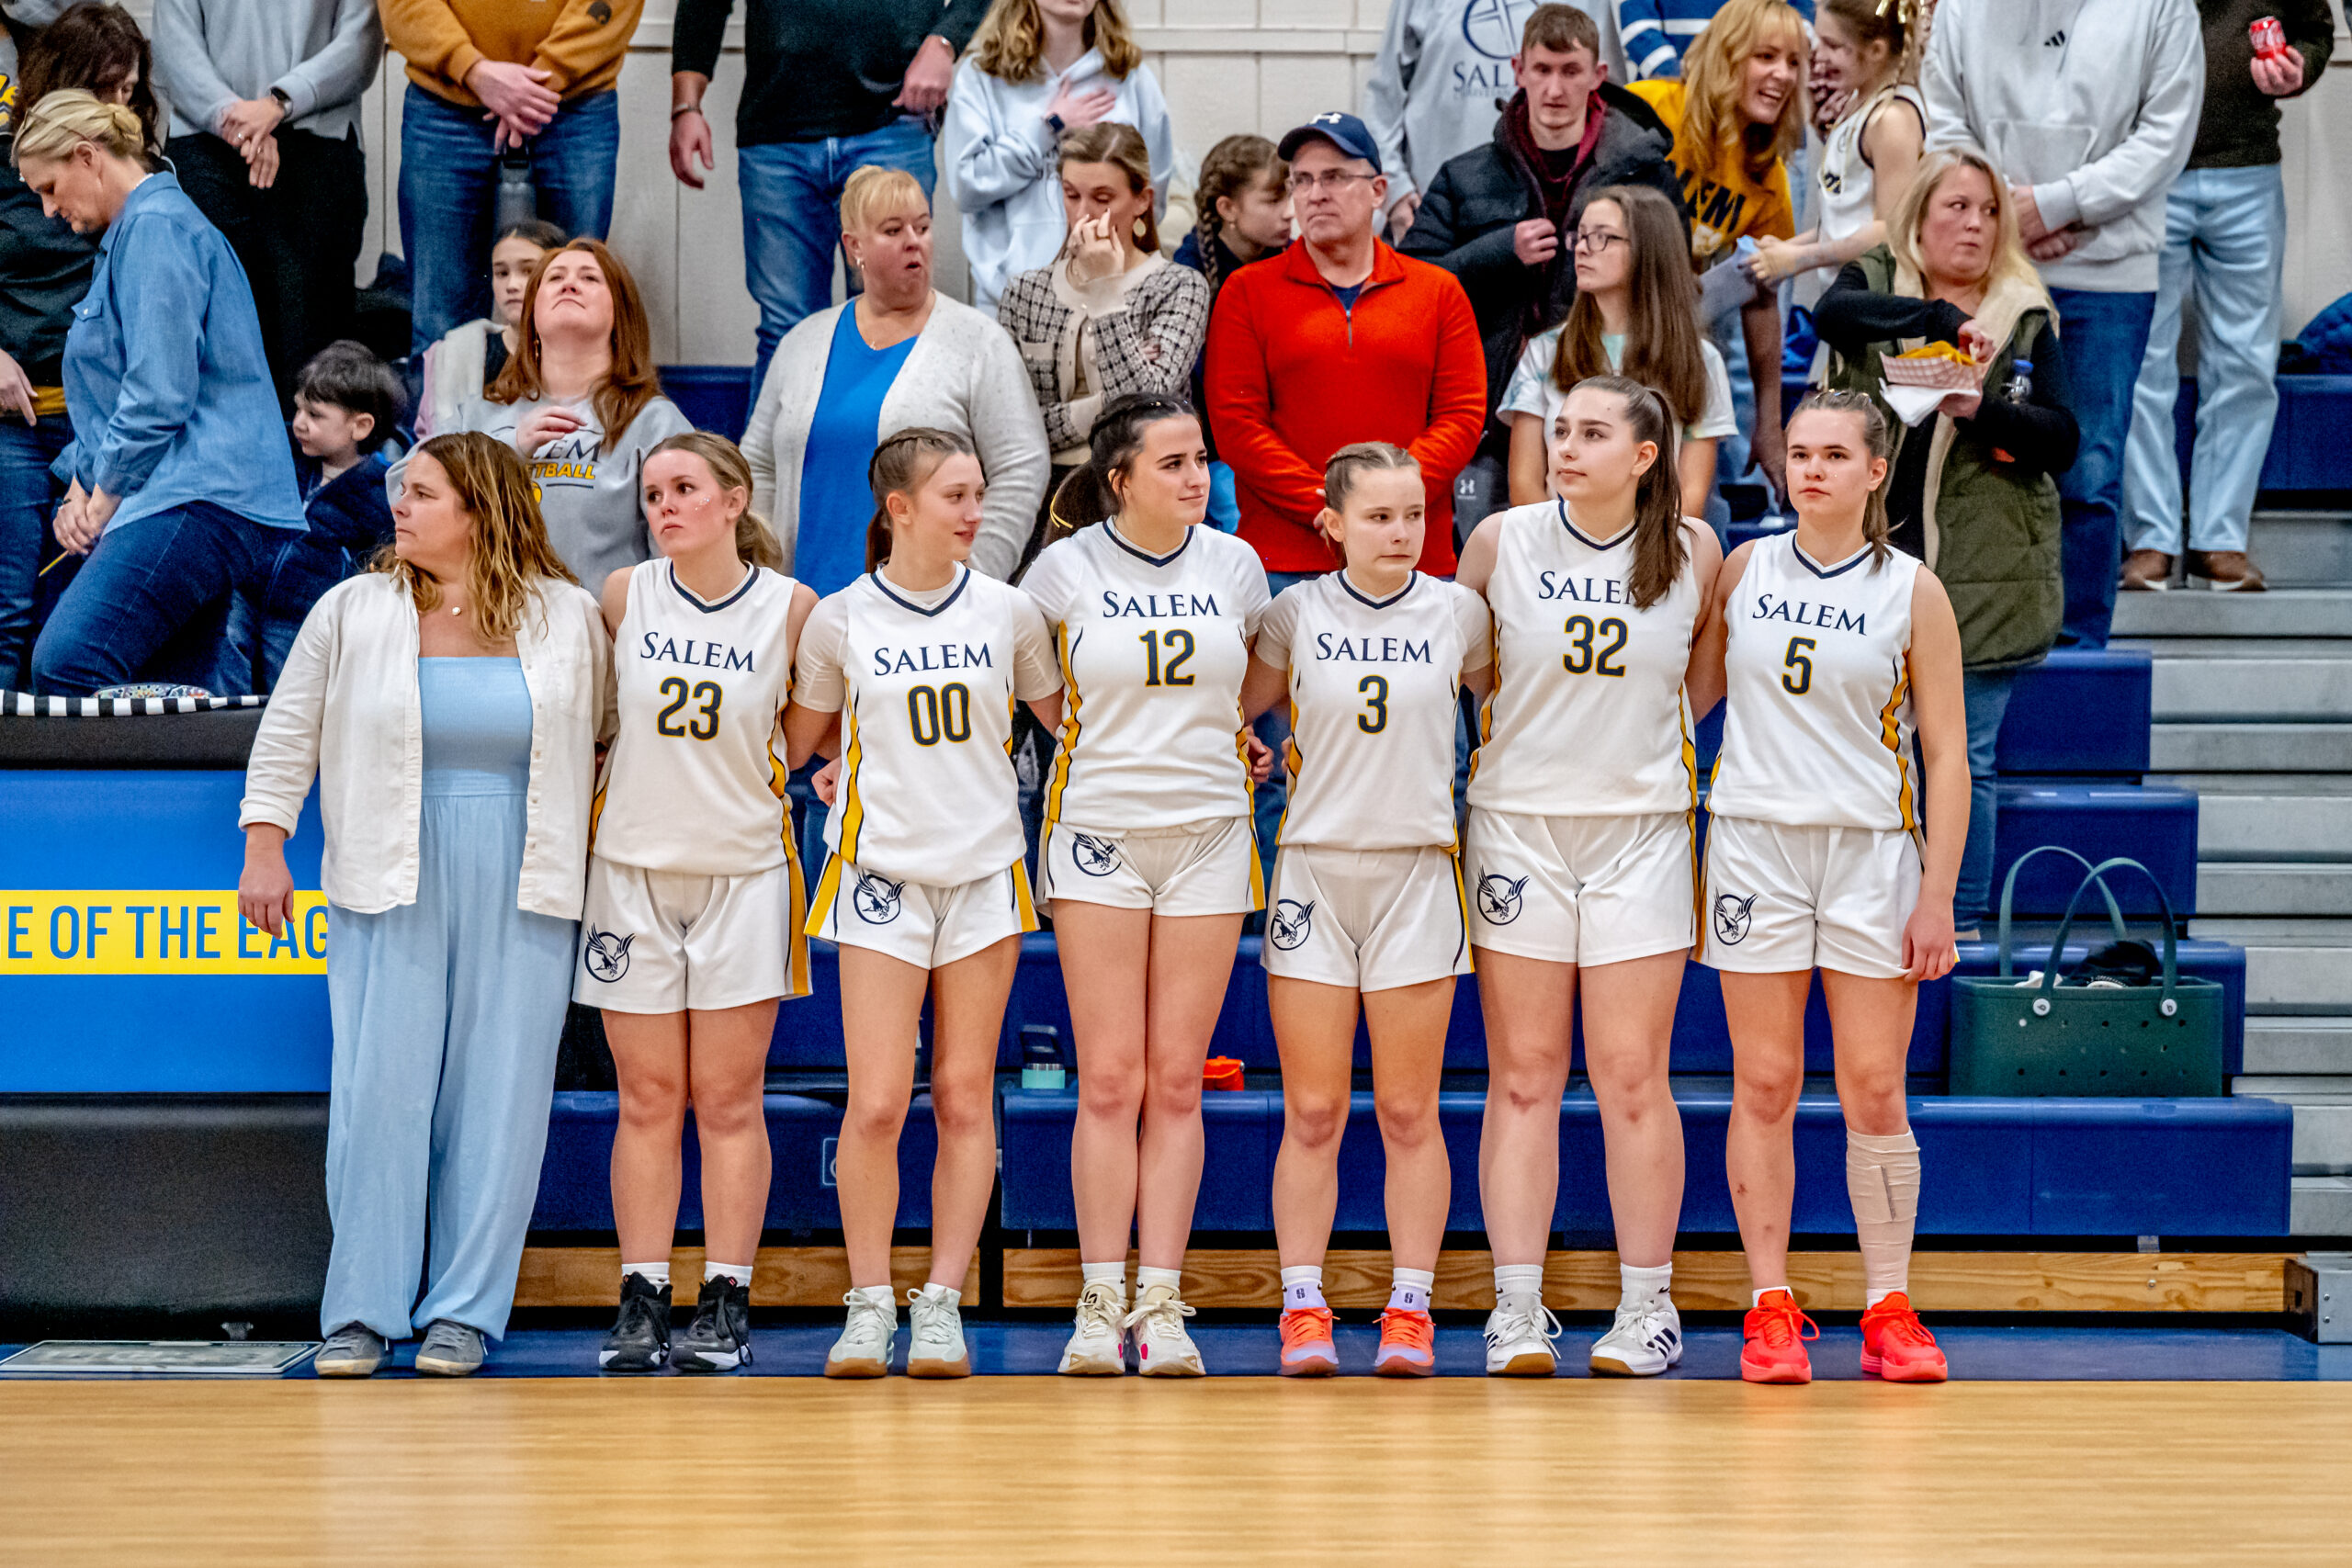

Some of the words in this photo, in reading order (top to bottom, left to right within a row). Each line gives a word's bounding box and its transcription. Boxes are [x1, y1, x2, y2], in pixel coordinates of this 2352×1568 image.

[1453, 61, 1510, 92] SAL
[533, 439, 603, 462] EM
[1102, 591, 1221, 618] SALEM
[1752, 593, 1867, 636] SALEM
[640, 631, 756, 673] SALEM
[874, 642, 993, 676] SALEM
[1139, 629, 1196, 688] 12
[1316, 632, 1433, 664] SALEM
[1563, 615, 1628, 678] 32
[1781, 636, 1817, 696] 5
[657, 676, 723, 741] 23
[907, 682, 971, 747] 00
[1357, 674, 1389, 735] 3
[0, 906, 33, 959] E
[51, 906, 112, 960] OF
[126, 906, 221, 959] THE
[238, 906, 329, 960] EAG
